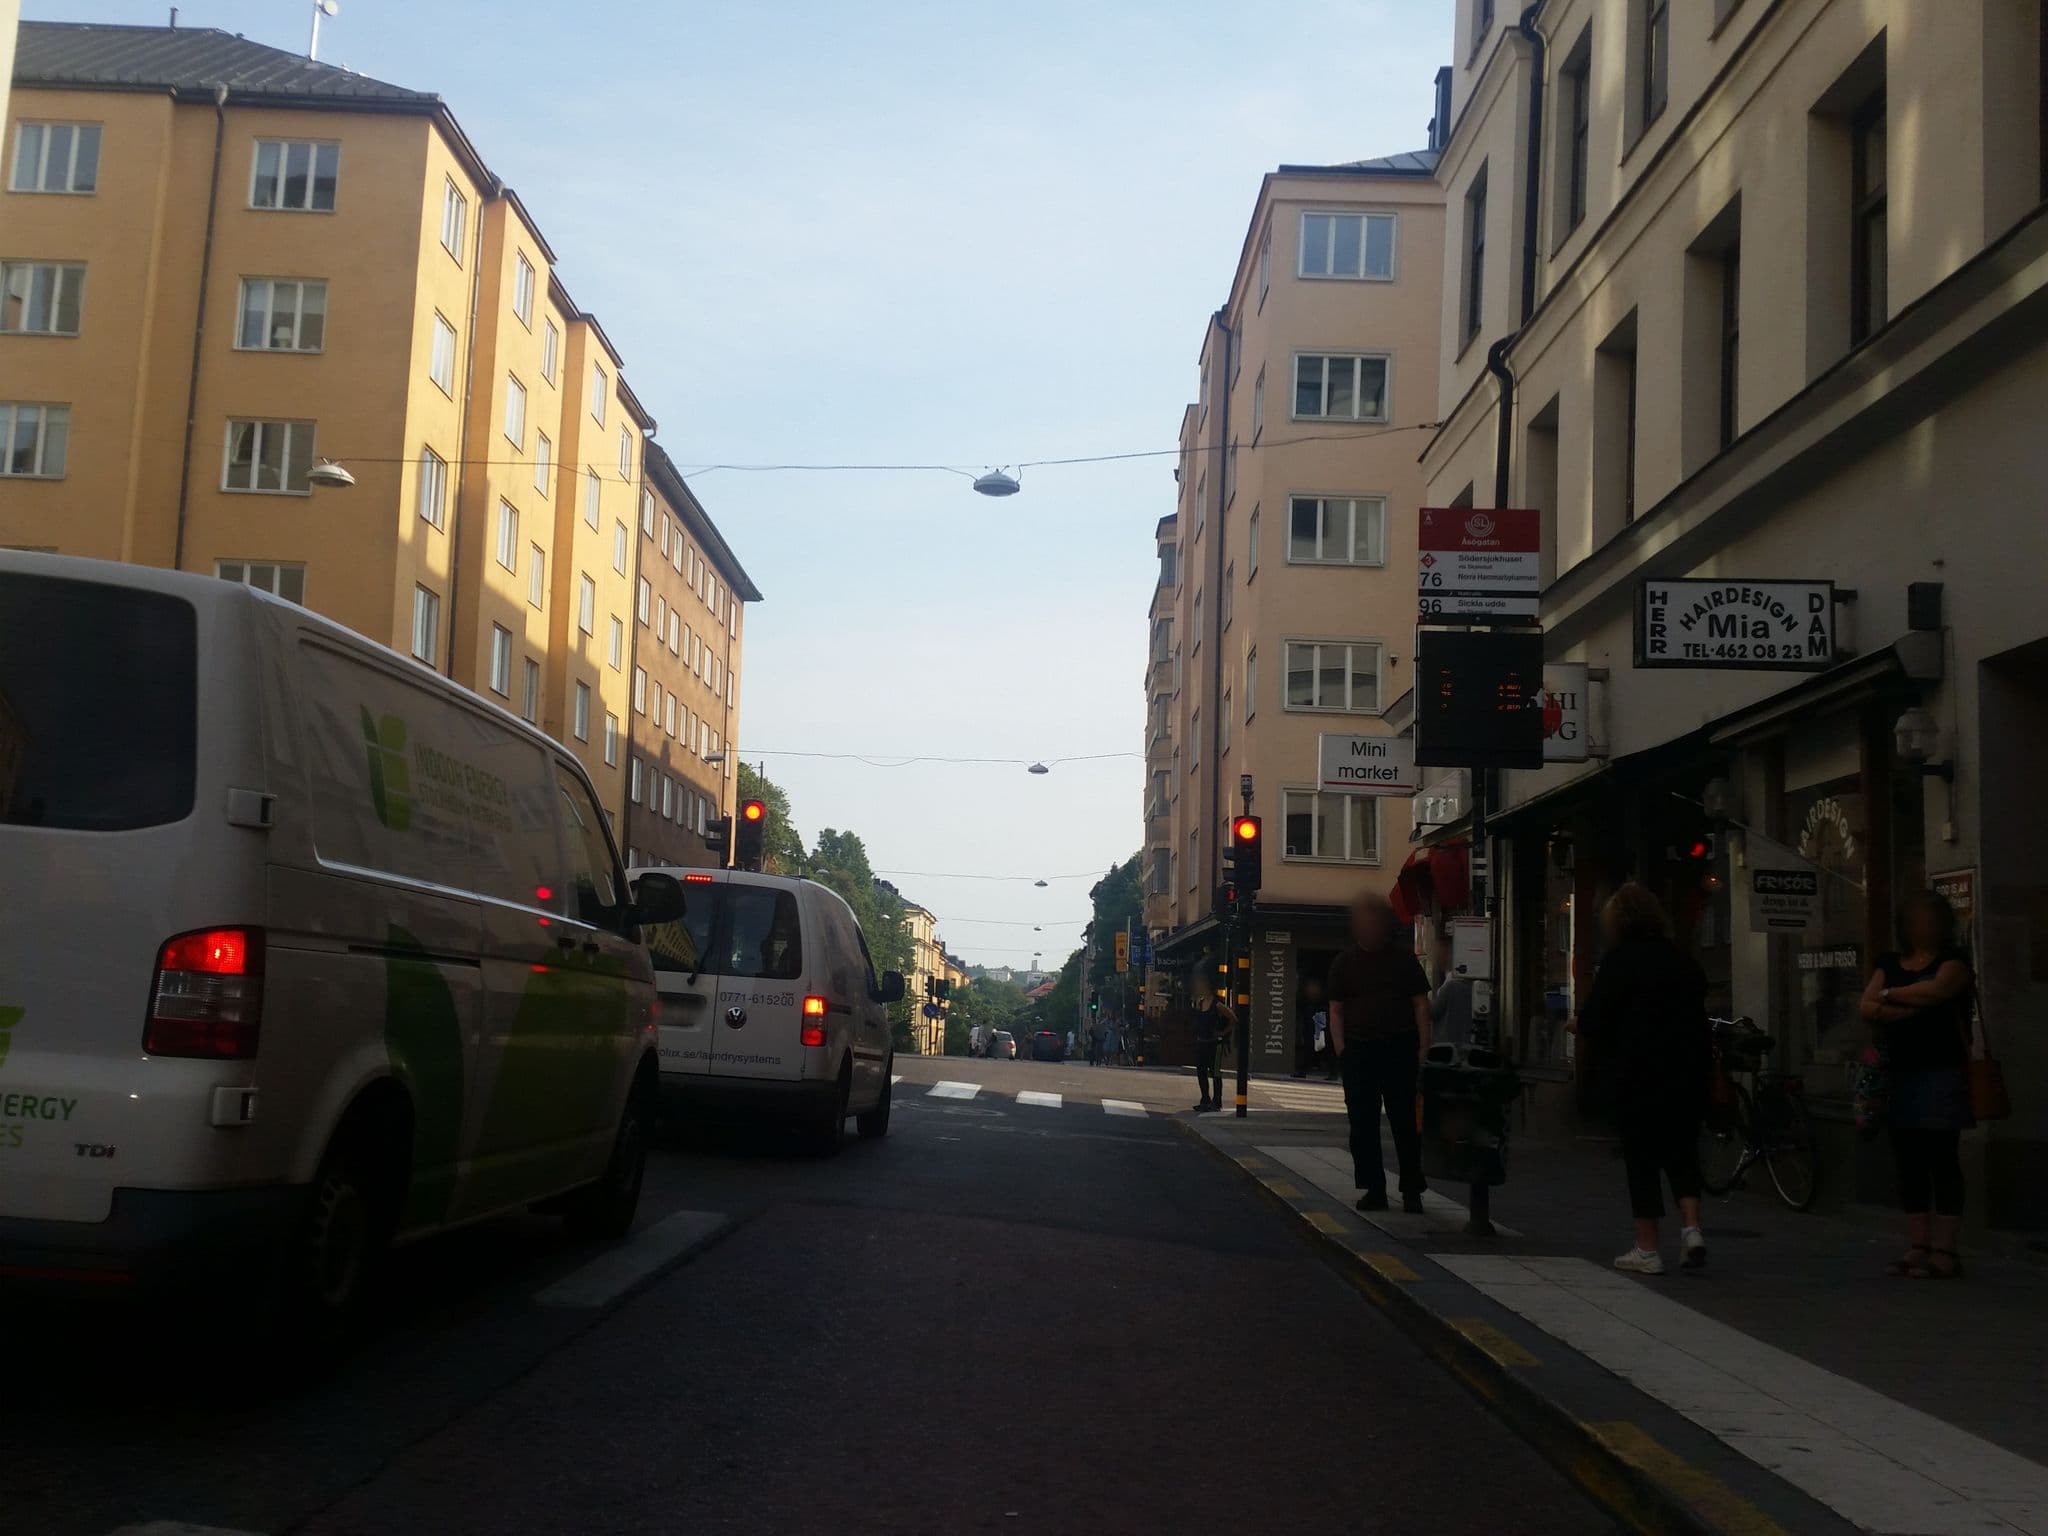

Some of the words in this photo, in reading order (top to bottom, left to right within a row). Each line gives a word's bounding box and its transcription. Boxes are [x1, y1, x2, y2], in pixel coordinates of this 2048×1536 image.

[1420, 572, 1442, 587] 76
[1419, 599, 1443, 614] 96
[1458, 599, 1483, 608] Sickla
[1485, 600, 1506, 608] udde
[1680, 587, 1799, 633] HAIRDESIGN
[1649, 590, 1668, 654] HERR
[1708, 613, 1771, 639] Mia
[1808, 592, 1828, 657] DAM
[1754, 644, 1777, 659] 08
[1782, 645, 1803, 660] 23
[1351, 740, 1387, 758] Mini
[1338, 764, 1400, 781] market
[1265, 947, 1288, 1056] Bistroteket
[0, 1093, 78, 1121] ERGY
